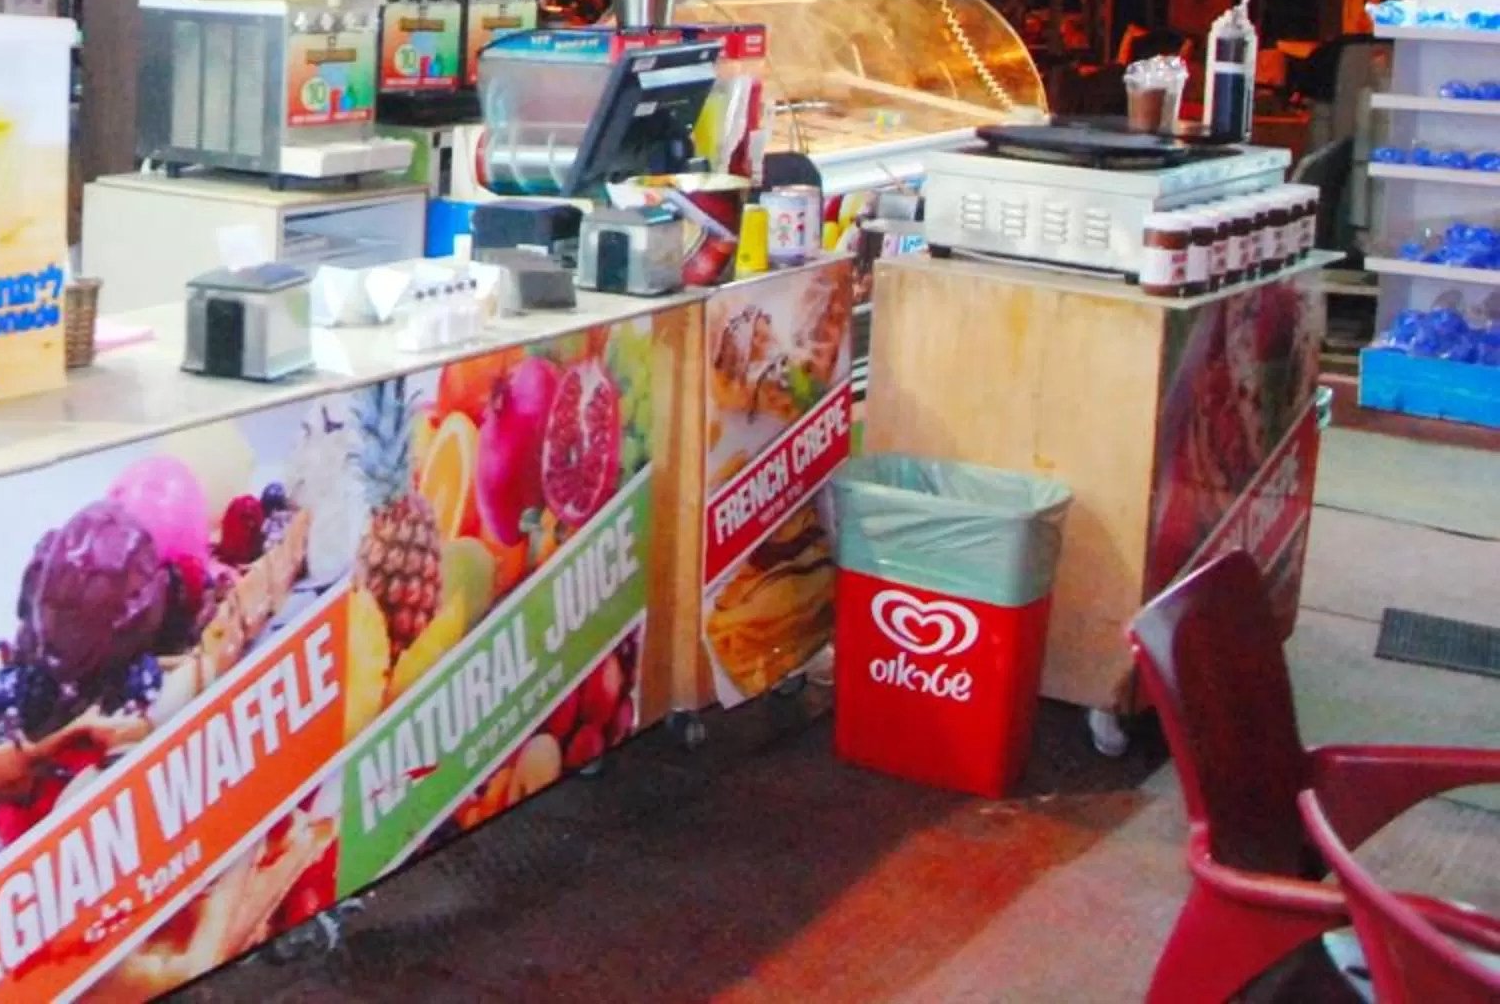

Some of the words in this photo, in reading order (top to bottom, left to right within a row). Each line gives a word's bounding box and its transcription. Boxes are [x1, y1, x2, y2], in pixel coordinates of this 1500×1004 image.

[714, 447, 789, 546] FRENCH
[792, 395, 849, 474] CREPE
[146, 621, 341, 842] WAFFLE
[357, 611, 538, 834] NATURAL
[545, 505, 639, 652] JUICE
